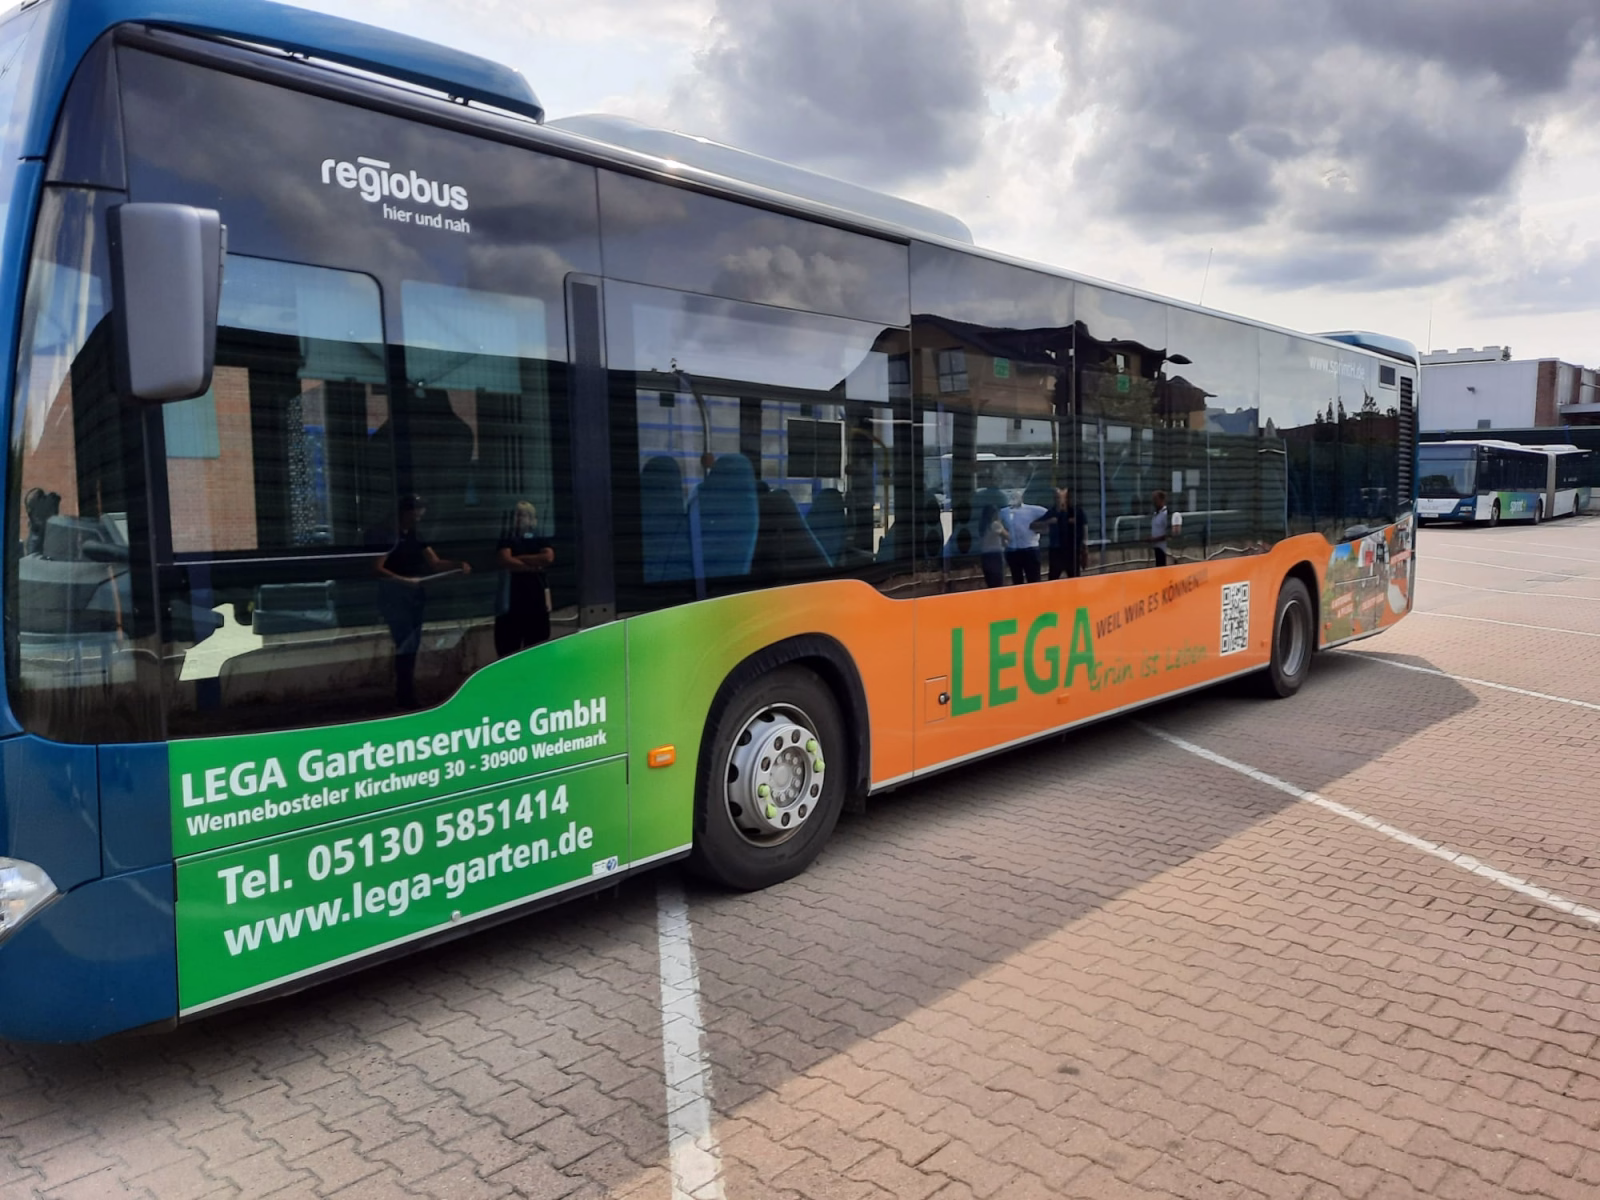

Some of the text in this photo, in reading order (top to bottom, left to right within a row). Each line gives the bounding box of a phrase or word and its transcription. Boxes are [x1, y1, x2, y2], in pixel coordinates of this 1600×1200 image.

[383, 203, 470, 233] hier und nah
[951, 607, 1095, 717] LEGA
[1096, 611, 1123, 640] WEIL
[1124, 599, 1146, 624] WIR
[1147, 594, 1160, 613] ES
[181, 696, 608, 808] LEGA Gartenservice GmbH
[186, 786, 349, 837] Wennebosteler
[354, 763, 440, 799] Kirchweg
[444, 760, 466, 781] 30
[480, 746, 528, 772] 30900
[531, 729, 608, 758] Wedemark
[217, 784, 569, 906] Tel. 05130 5851414
[223, 821, 594, 957] www.lega-garten.de
